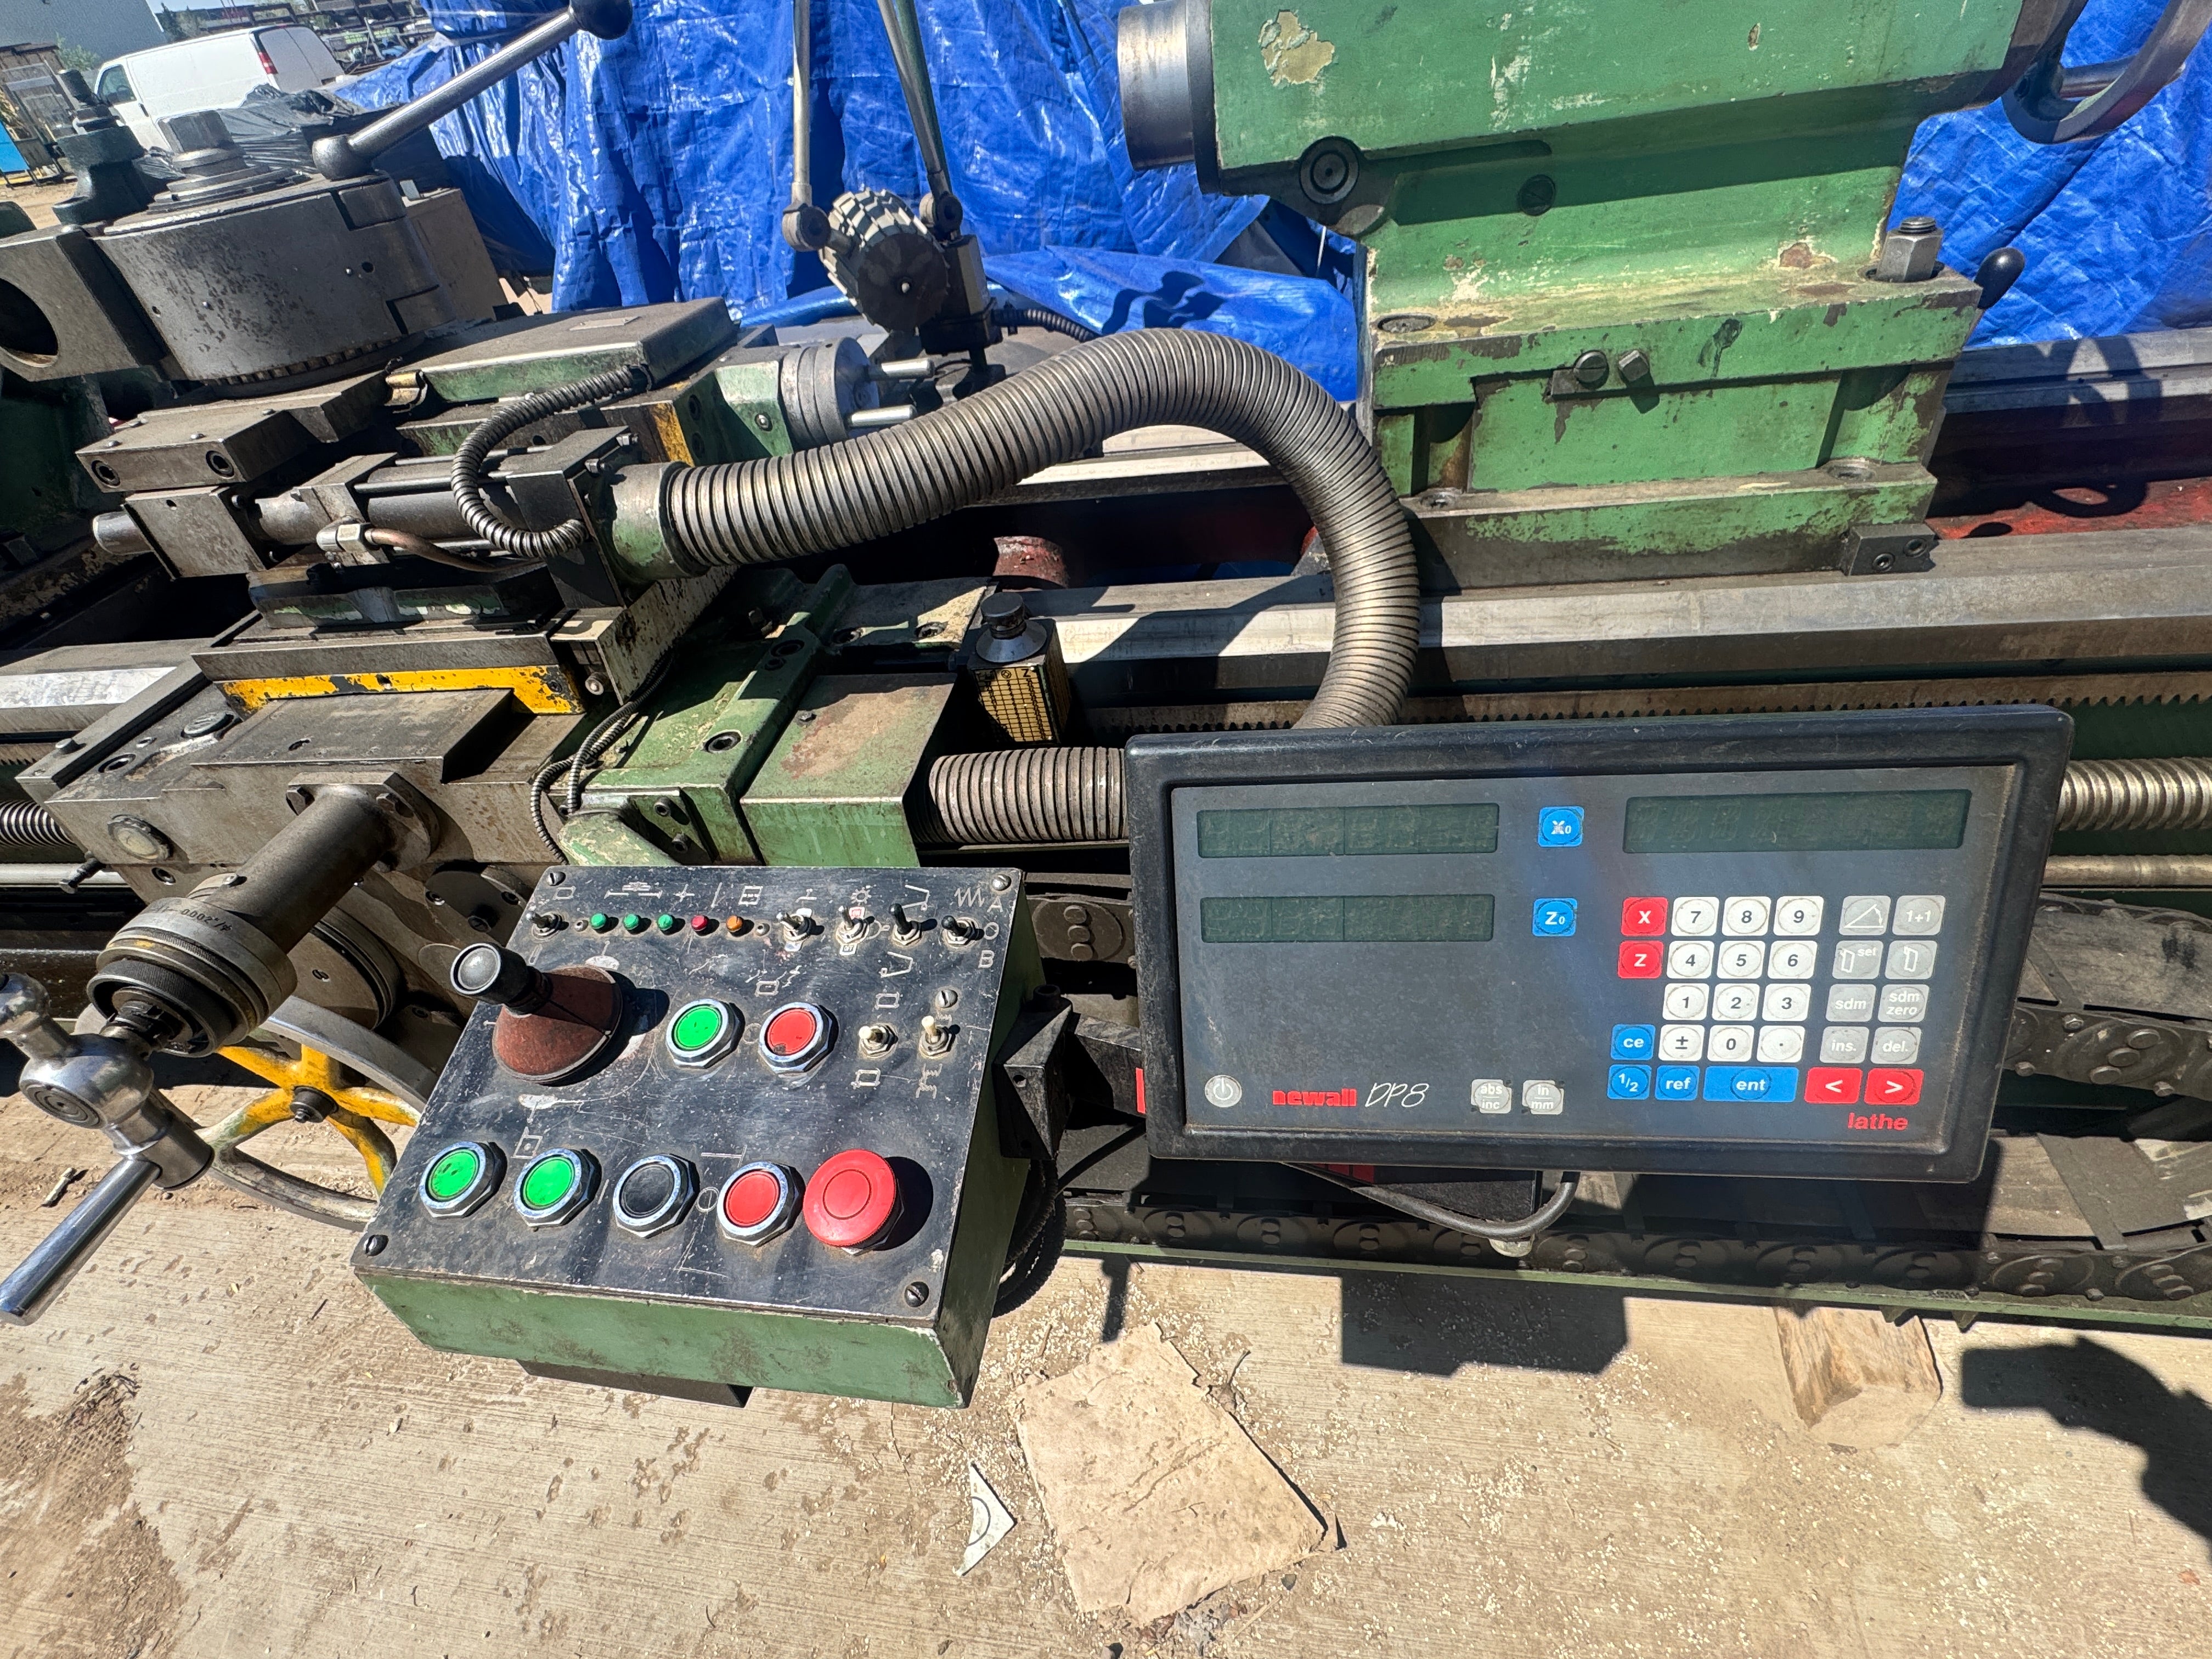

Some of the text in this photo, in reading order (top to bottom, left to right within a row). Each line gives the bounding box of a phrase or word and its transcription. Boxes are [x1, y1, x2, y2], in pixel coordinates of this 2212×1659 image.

[1021, 668, 1031, 678] Z
[987, 895, 1003, 913] A
[1638, 911, 1650, 924] X
[1691, 912, 1700, 923] 7
[1741, 911, 1752, 923] 8
[1794, 911, 1804, 923] 9
[1906, 910, 1931, 922] 1+1
[978, 950, 995, 968] B
[1634, 953, 1646, 966] Z
[1685, 955, 1695, 967] 4
[1736, 955, 1746, 967] 5
[1788, 955, 1798, 967] 6
[1683, 997, 1689, 1008] 1
[1889, 991, 1919, 1003] sdm
[1731, 998, 1741, 1009] 2
[1782, 998, 1791, 1009] 3
[1835, 998, 1865, 1010] sdm
[1887, 1005, 1917, 1015] zero
[1623, 1036, 1644, 1047] ce
[1726, 1039, 1736, 1051] 0
[1831, 1040, 1857, 1052] ins.
[1883, 1040, 1908, 1052] del.
[1480, 1084, 1502, 1094] abs
[1537, 1084, 1549, 1094] in
[1666, 1077, 1690, 1089] ref
[1736, 1079, 1765, 1091] ent
[1273, 1082, 1429, 1108] newall DP8
[1481, 1099, 1500, 1110] inc
[1531, 1100, 1554, 1110] mm
[1847, 1113, 1908, 1131] lathe
